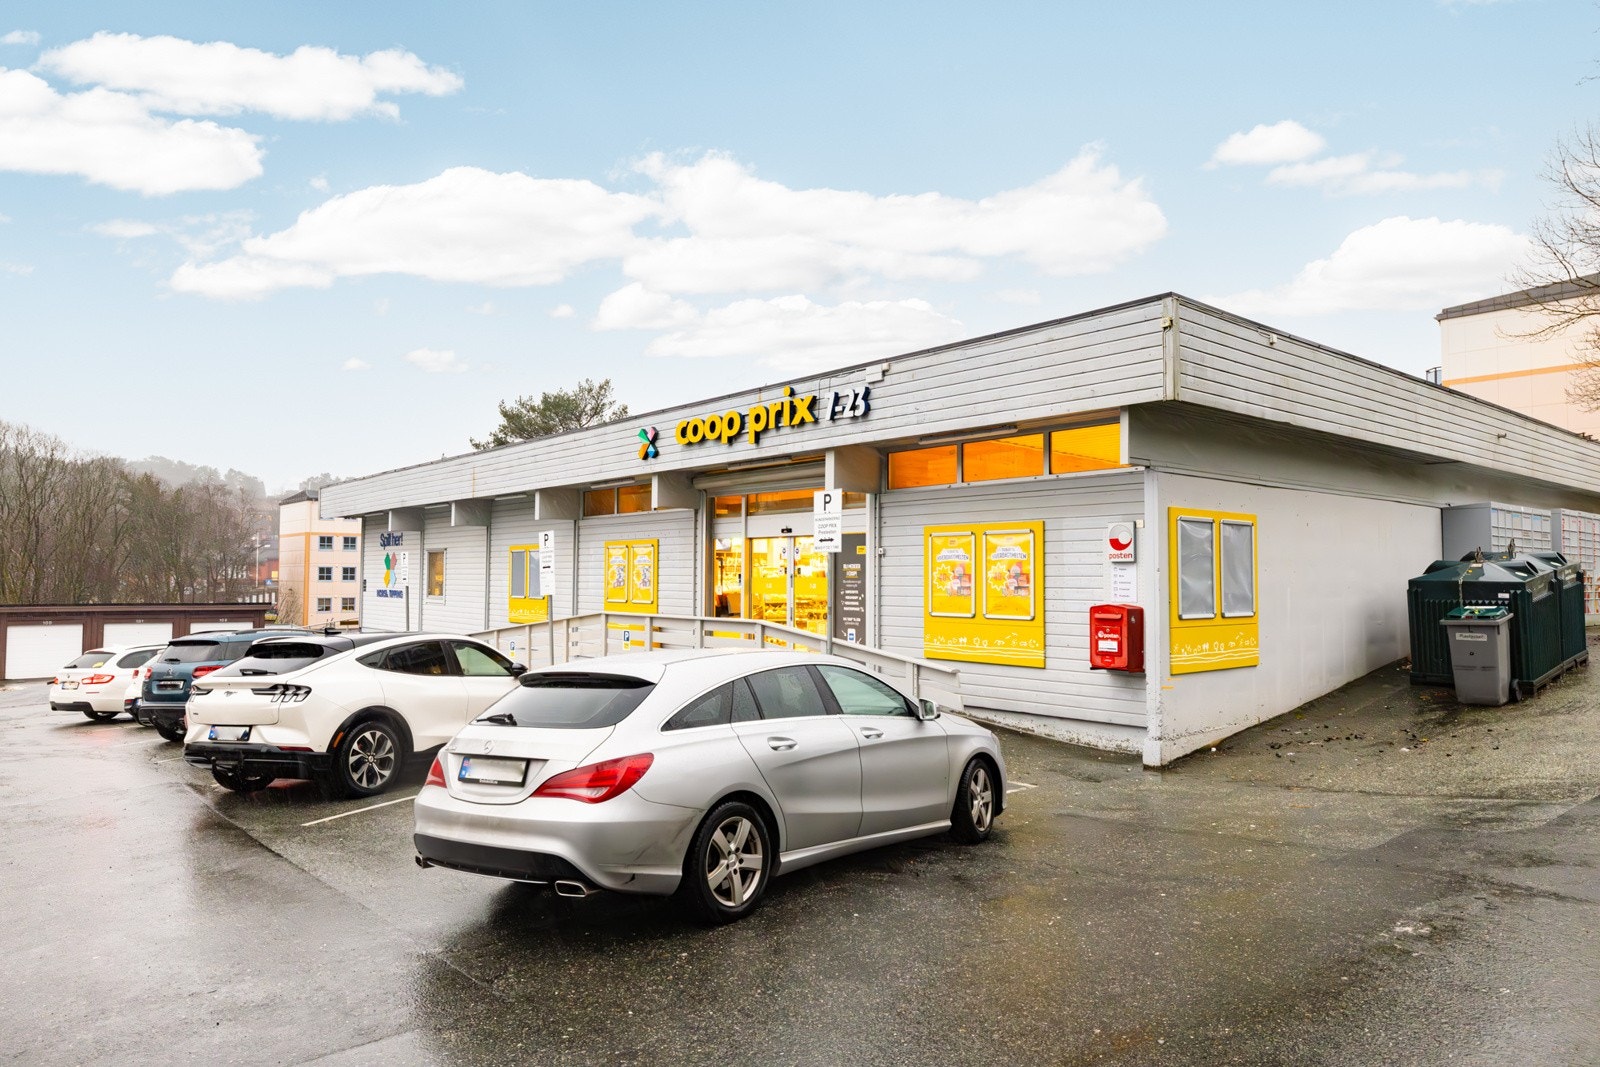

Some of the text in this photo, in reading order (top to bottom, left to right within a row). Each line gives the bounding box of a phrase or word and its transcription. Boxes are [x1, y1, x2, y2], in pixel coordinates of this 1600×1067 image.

[675, 386, 816, 445] coop prix
[824, 493, 832, 511] P
[544, 533, 549, 547] P
